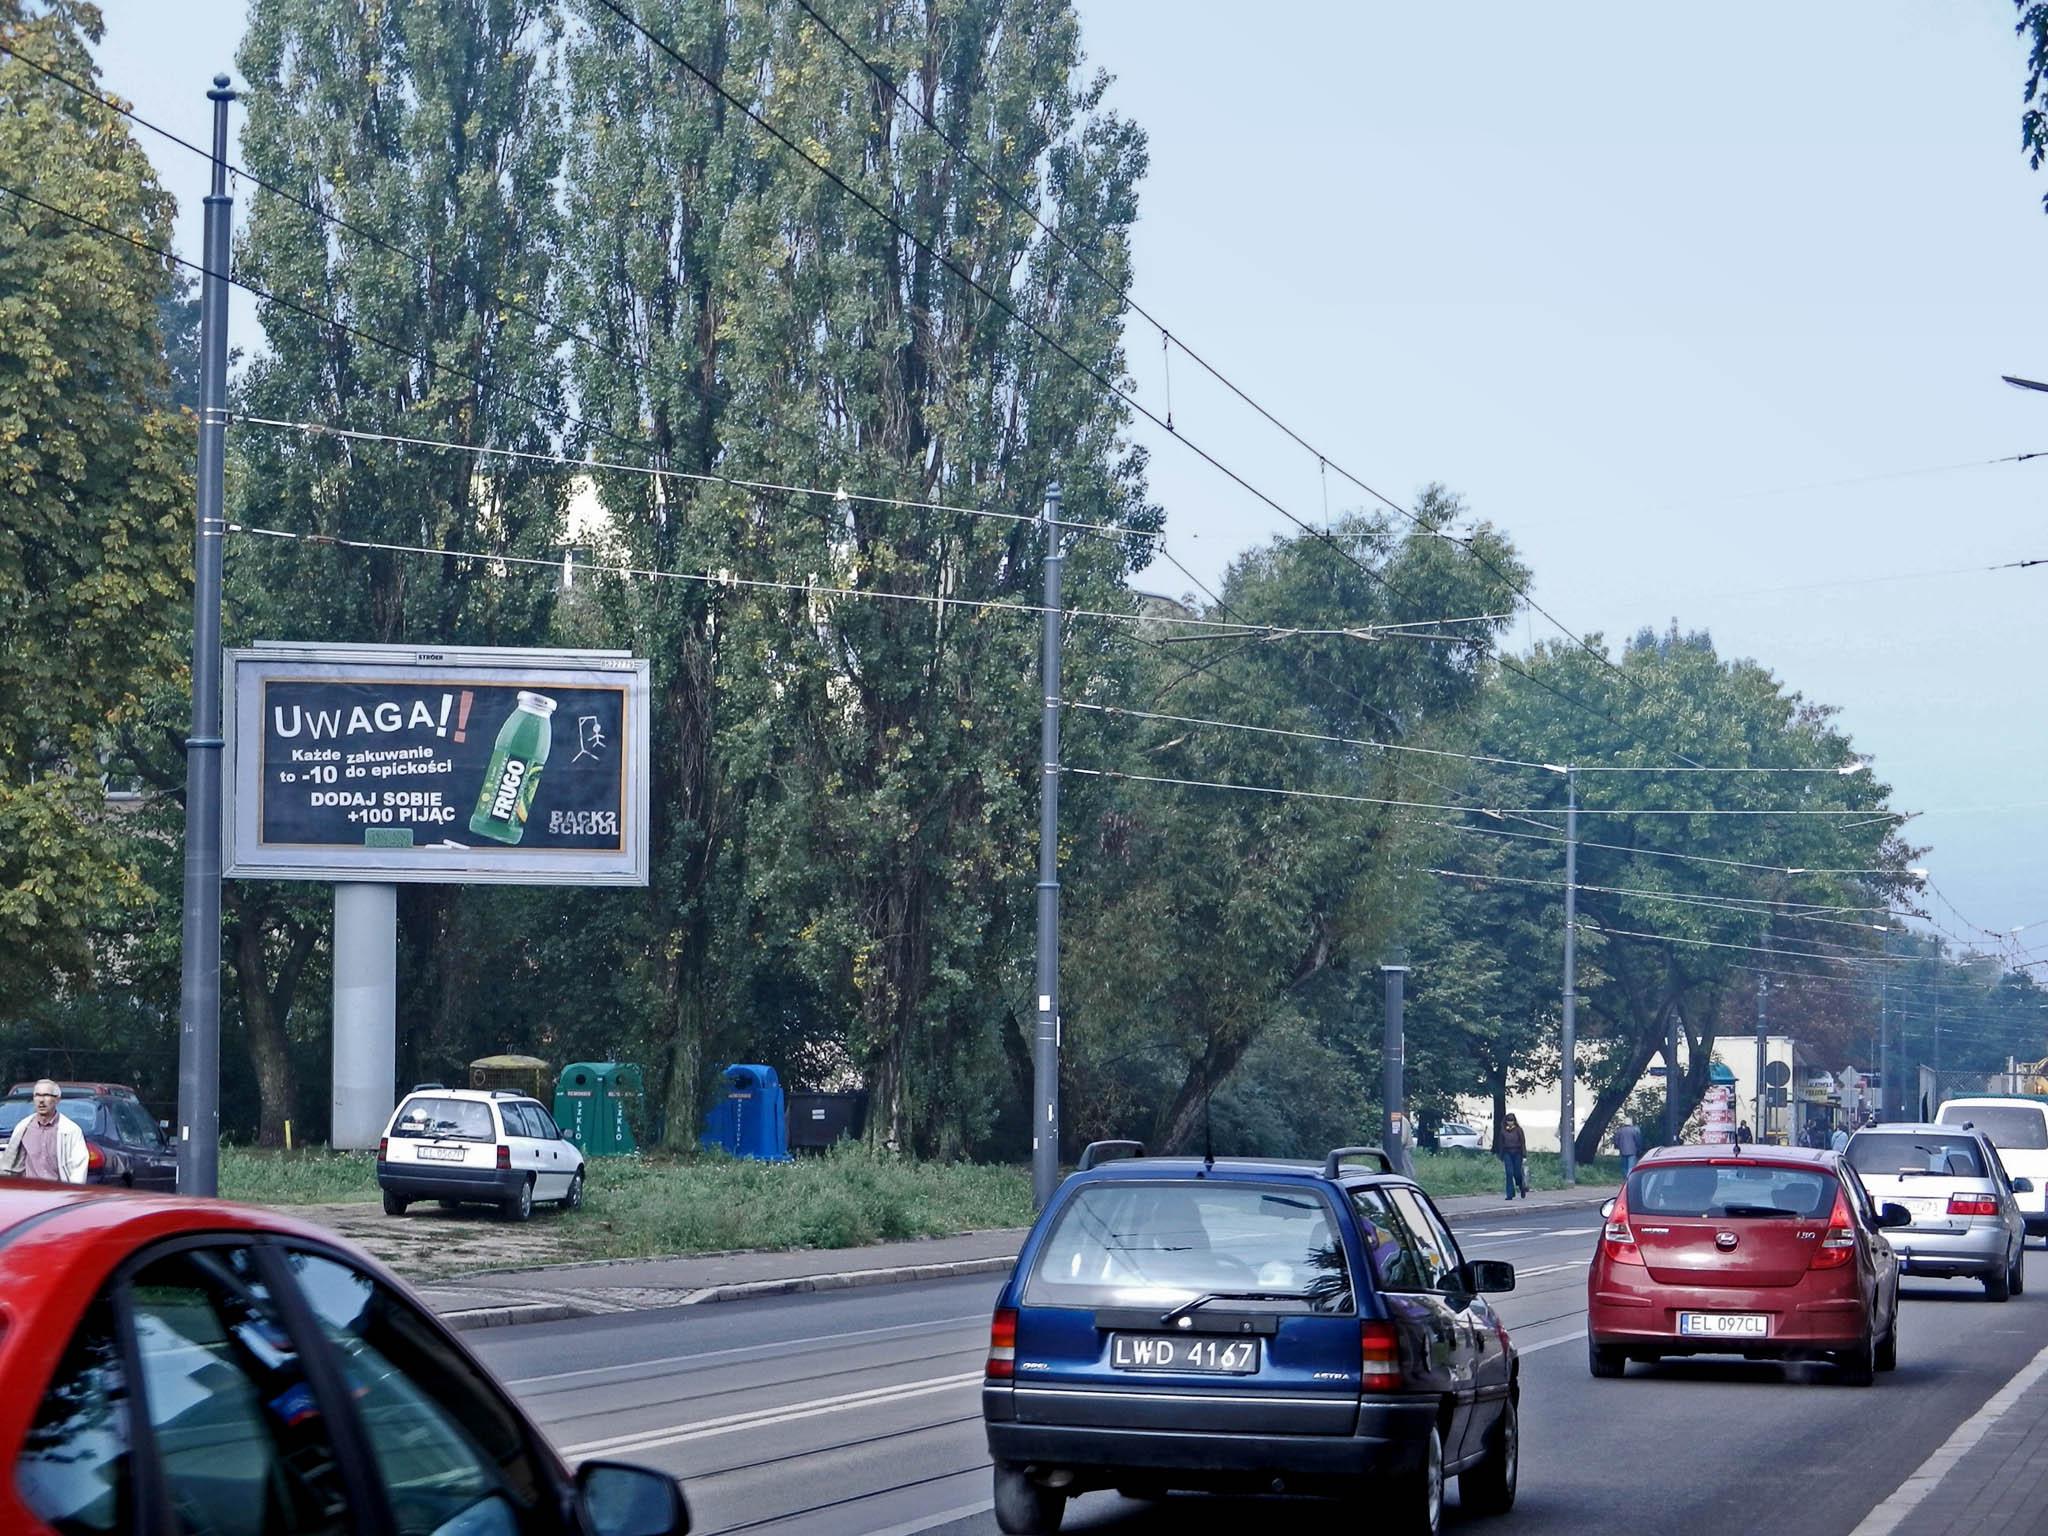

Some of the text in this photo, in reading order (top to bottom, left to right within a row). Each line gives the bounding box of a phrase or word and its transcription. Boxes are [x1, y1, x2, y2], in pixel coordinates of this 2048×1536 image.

[292, 746, 434, 764] Każde zakuwanie
[280, 759, 452, 784] to -10 do epickości
[492, 760, 526, 820] FRUGO
[311, 792, 443, 807] DODAJ SOBIE
[347, 807, 456, 825] +100 PIJĄC
[551, 810, 616, 824] BACK2
[549, 820, 619, 835] SCHOOL
[1691, 1316, 1763, 1332] EL 097CL
[1116, 1340, 1253, 1368] LWD 4167
